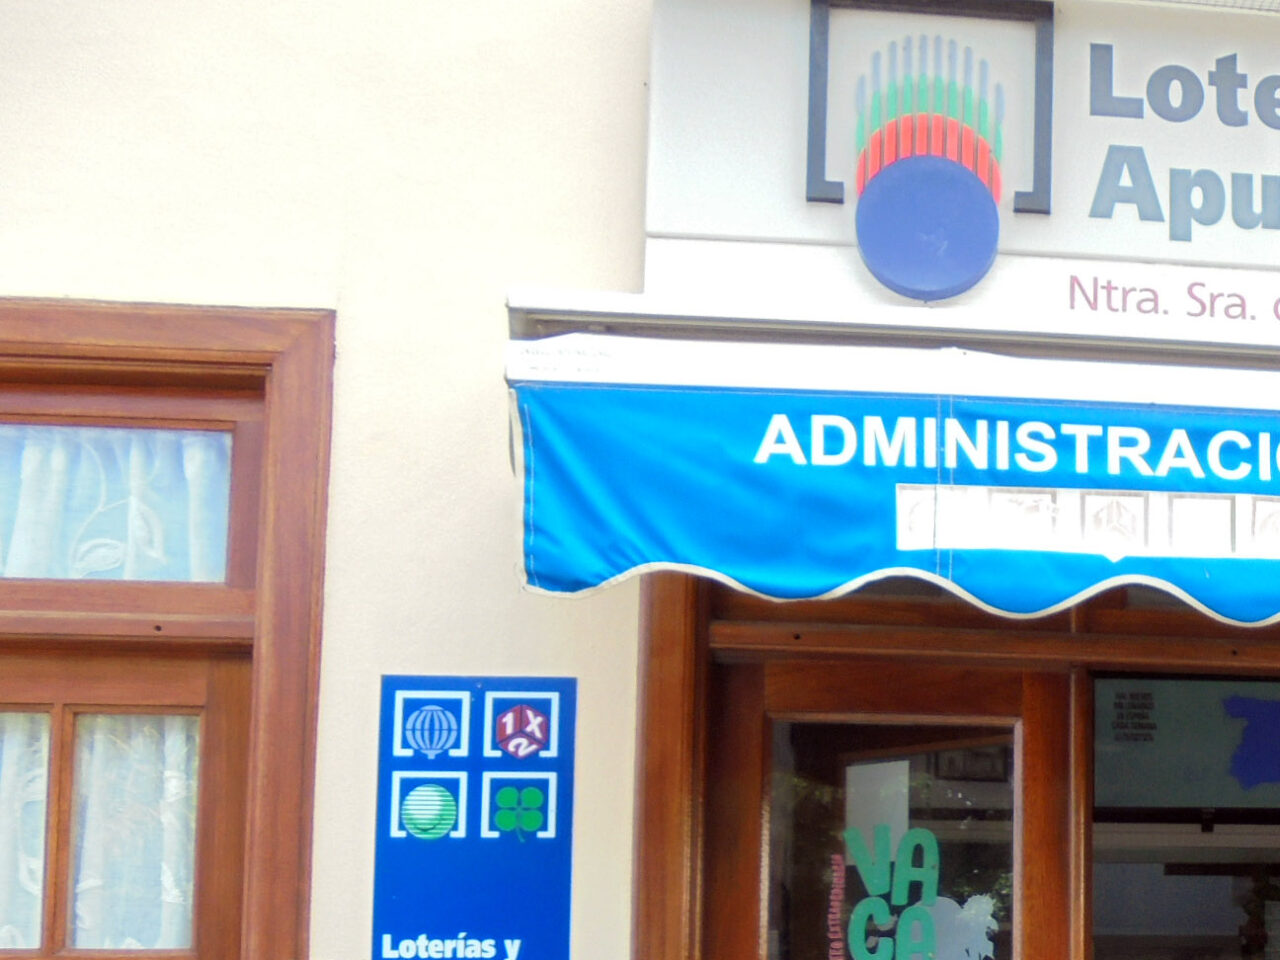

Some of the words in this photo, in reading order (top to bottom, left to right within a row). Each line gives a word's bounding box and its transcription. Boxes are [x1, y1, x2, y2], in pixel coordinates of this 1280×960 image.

[1069, 275, 1169, 316] Ntra.
[1187, 282, 1257, 321] Sra.
[382, 932, 497, 959] Loterías
